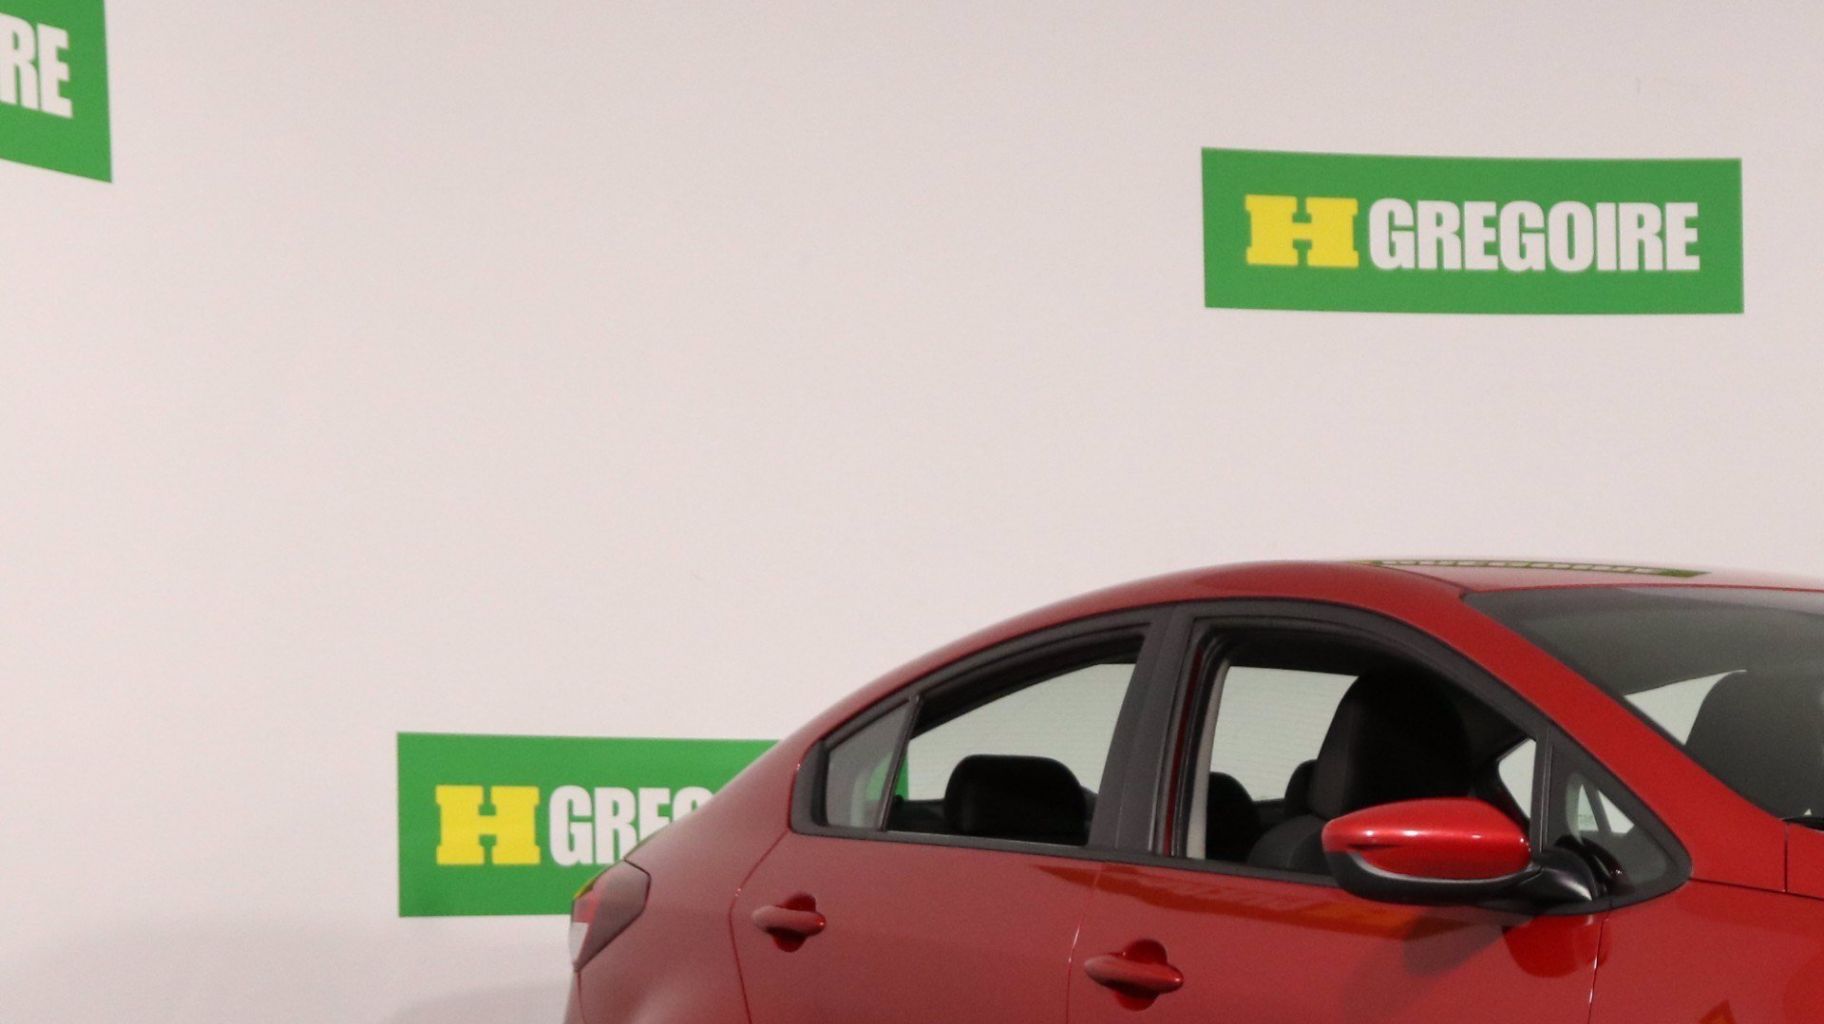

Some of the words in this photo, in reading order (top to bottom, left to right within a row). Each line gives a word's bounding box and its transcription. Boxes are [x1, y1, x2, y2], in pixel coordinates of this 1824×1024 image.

[1244, 194, 1359, 268] H
[1368, 197, 1700, 272] GREGOIRE
[435, 785, 541, 866] H
